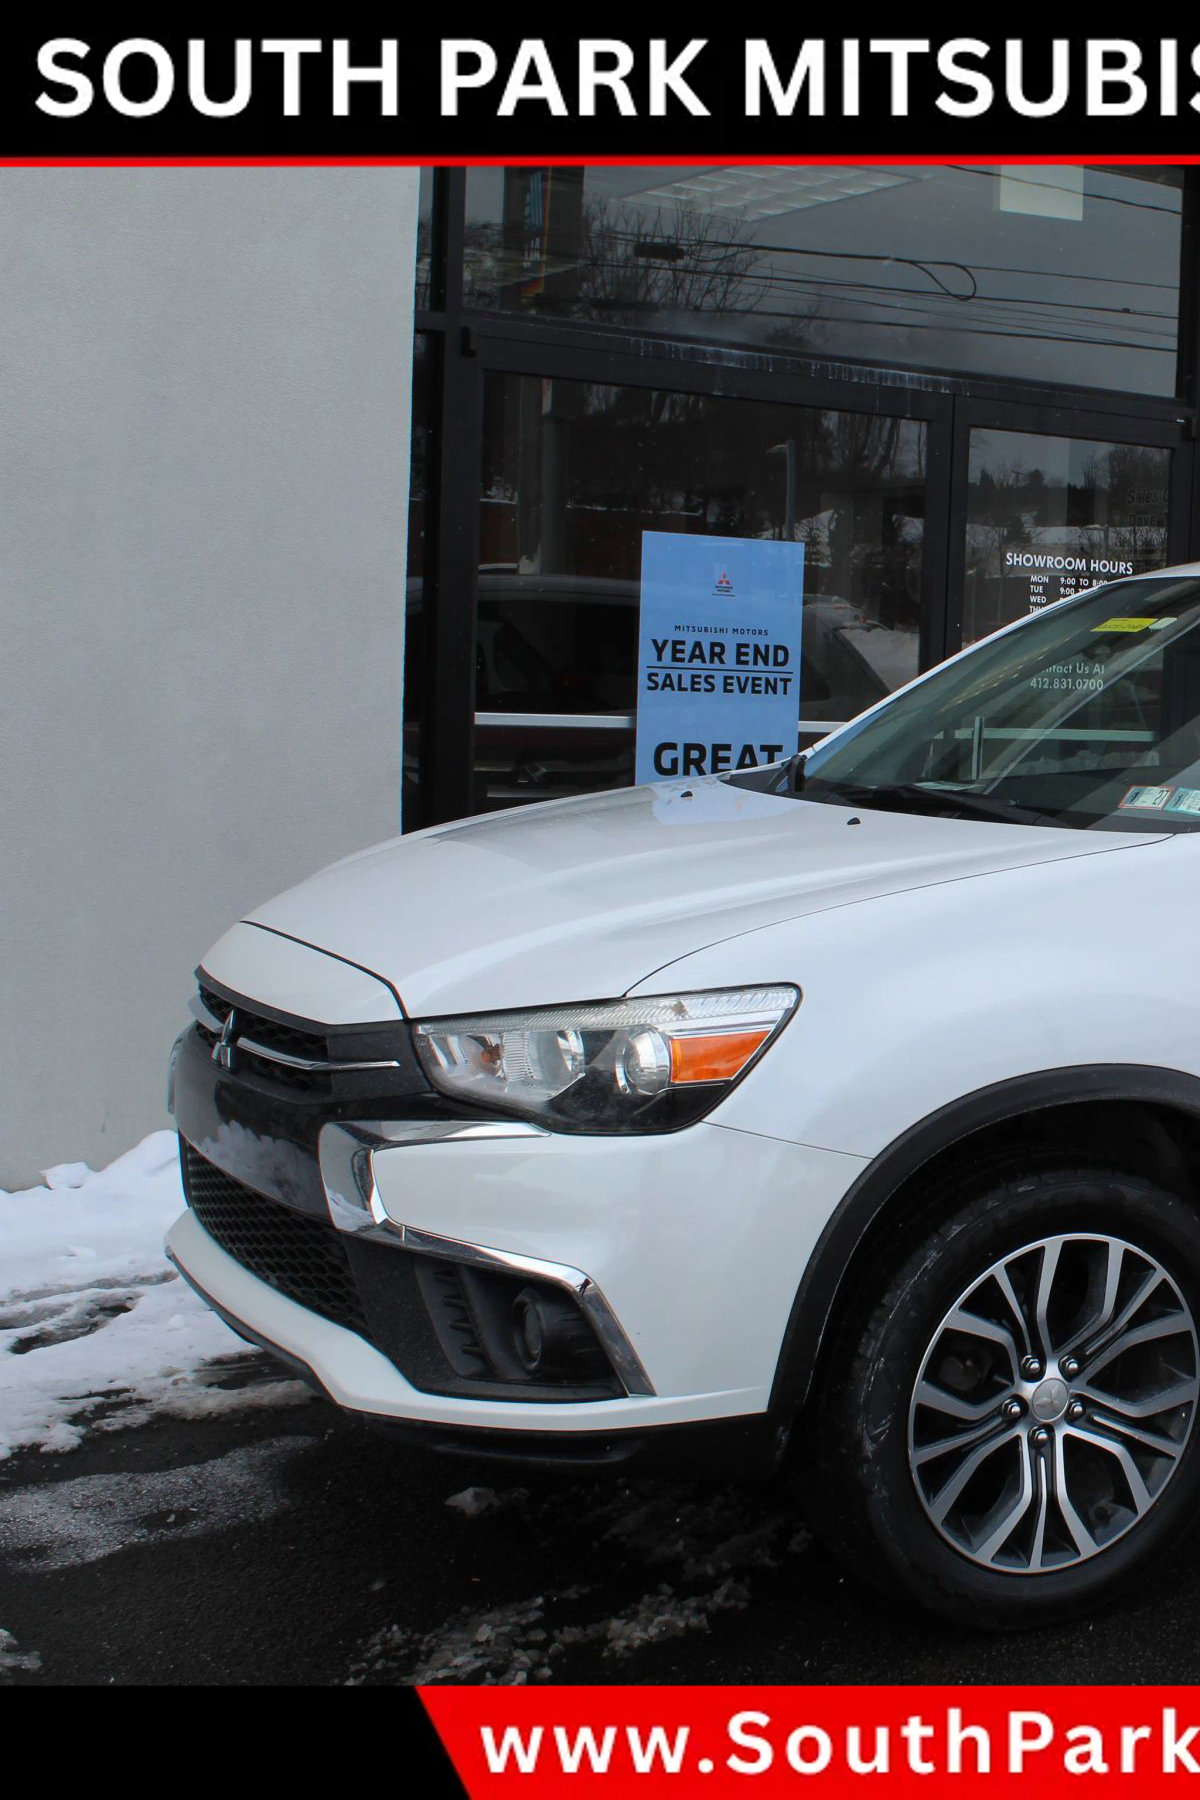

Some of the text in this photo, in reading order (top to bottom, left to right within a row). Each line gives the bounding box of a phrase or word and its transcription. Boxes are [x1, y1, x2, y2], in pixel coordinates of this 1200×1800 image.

[1005, 552, 1133, 575] SHOWROOM HOURS
[1030, 575, 1049, 584] MON
[1060, 577, 1076, 585] 9:00
[1079, 578, 1089, 586] TO
[1030, 585, 1044, 593] TUE
[1059, 587, 1075, 595] 9:00
[1029, 595, 1047, 604] WED
[674, 624, 769, 637] MITSUBISHI MOTORS
[651, 638, 790, 667] YEAR END
[1076, 662, 1090, 674] Us
[646, 672, 793, 696] SALES EVENT
[1030, 677, 1104, 690] 412.831.0700
[653, 742, 784, 777] GREAT
[1152, 789, 1169, 805] 27
